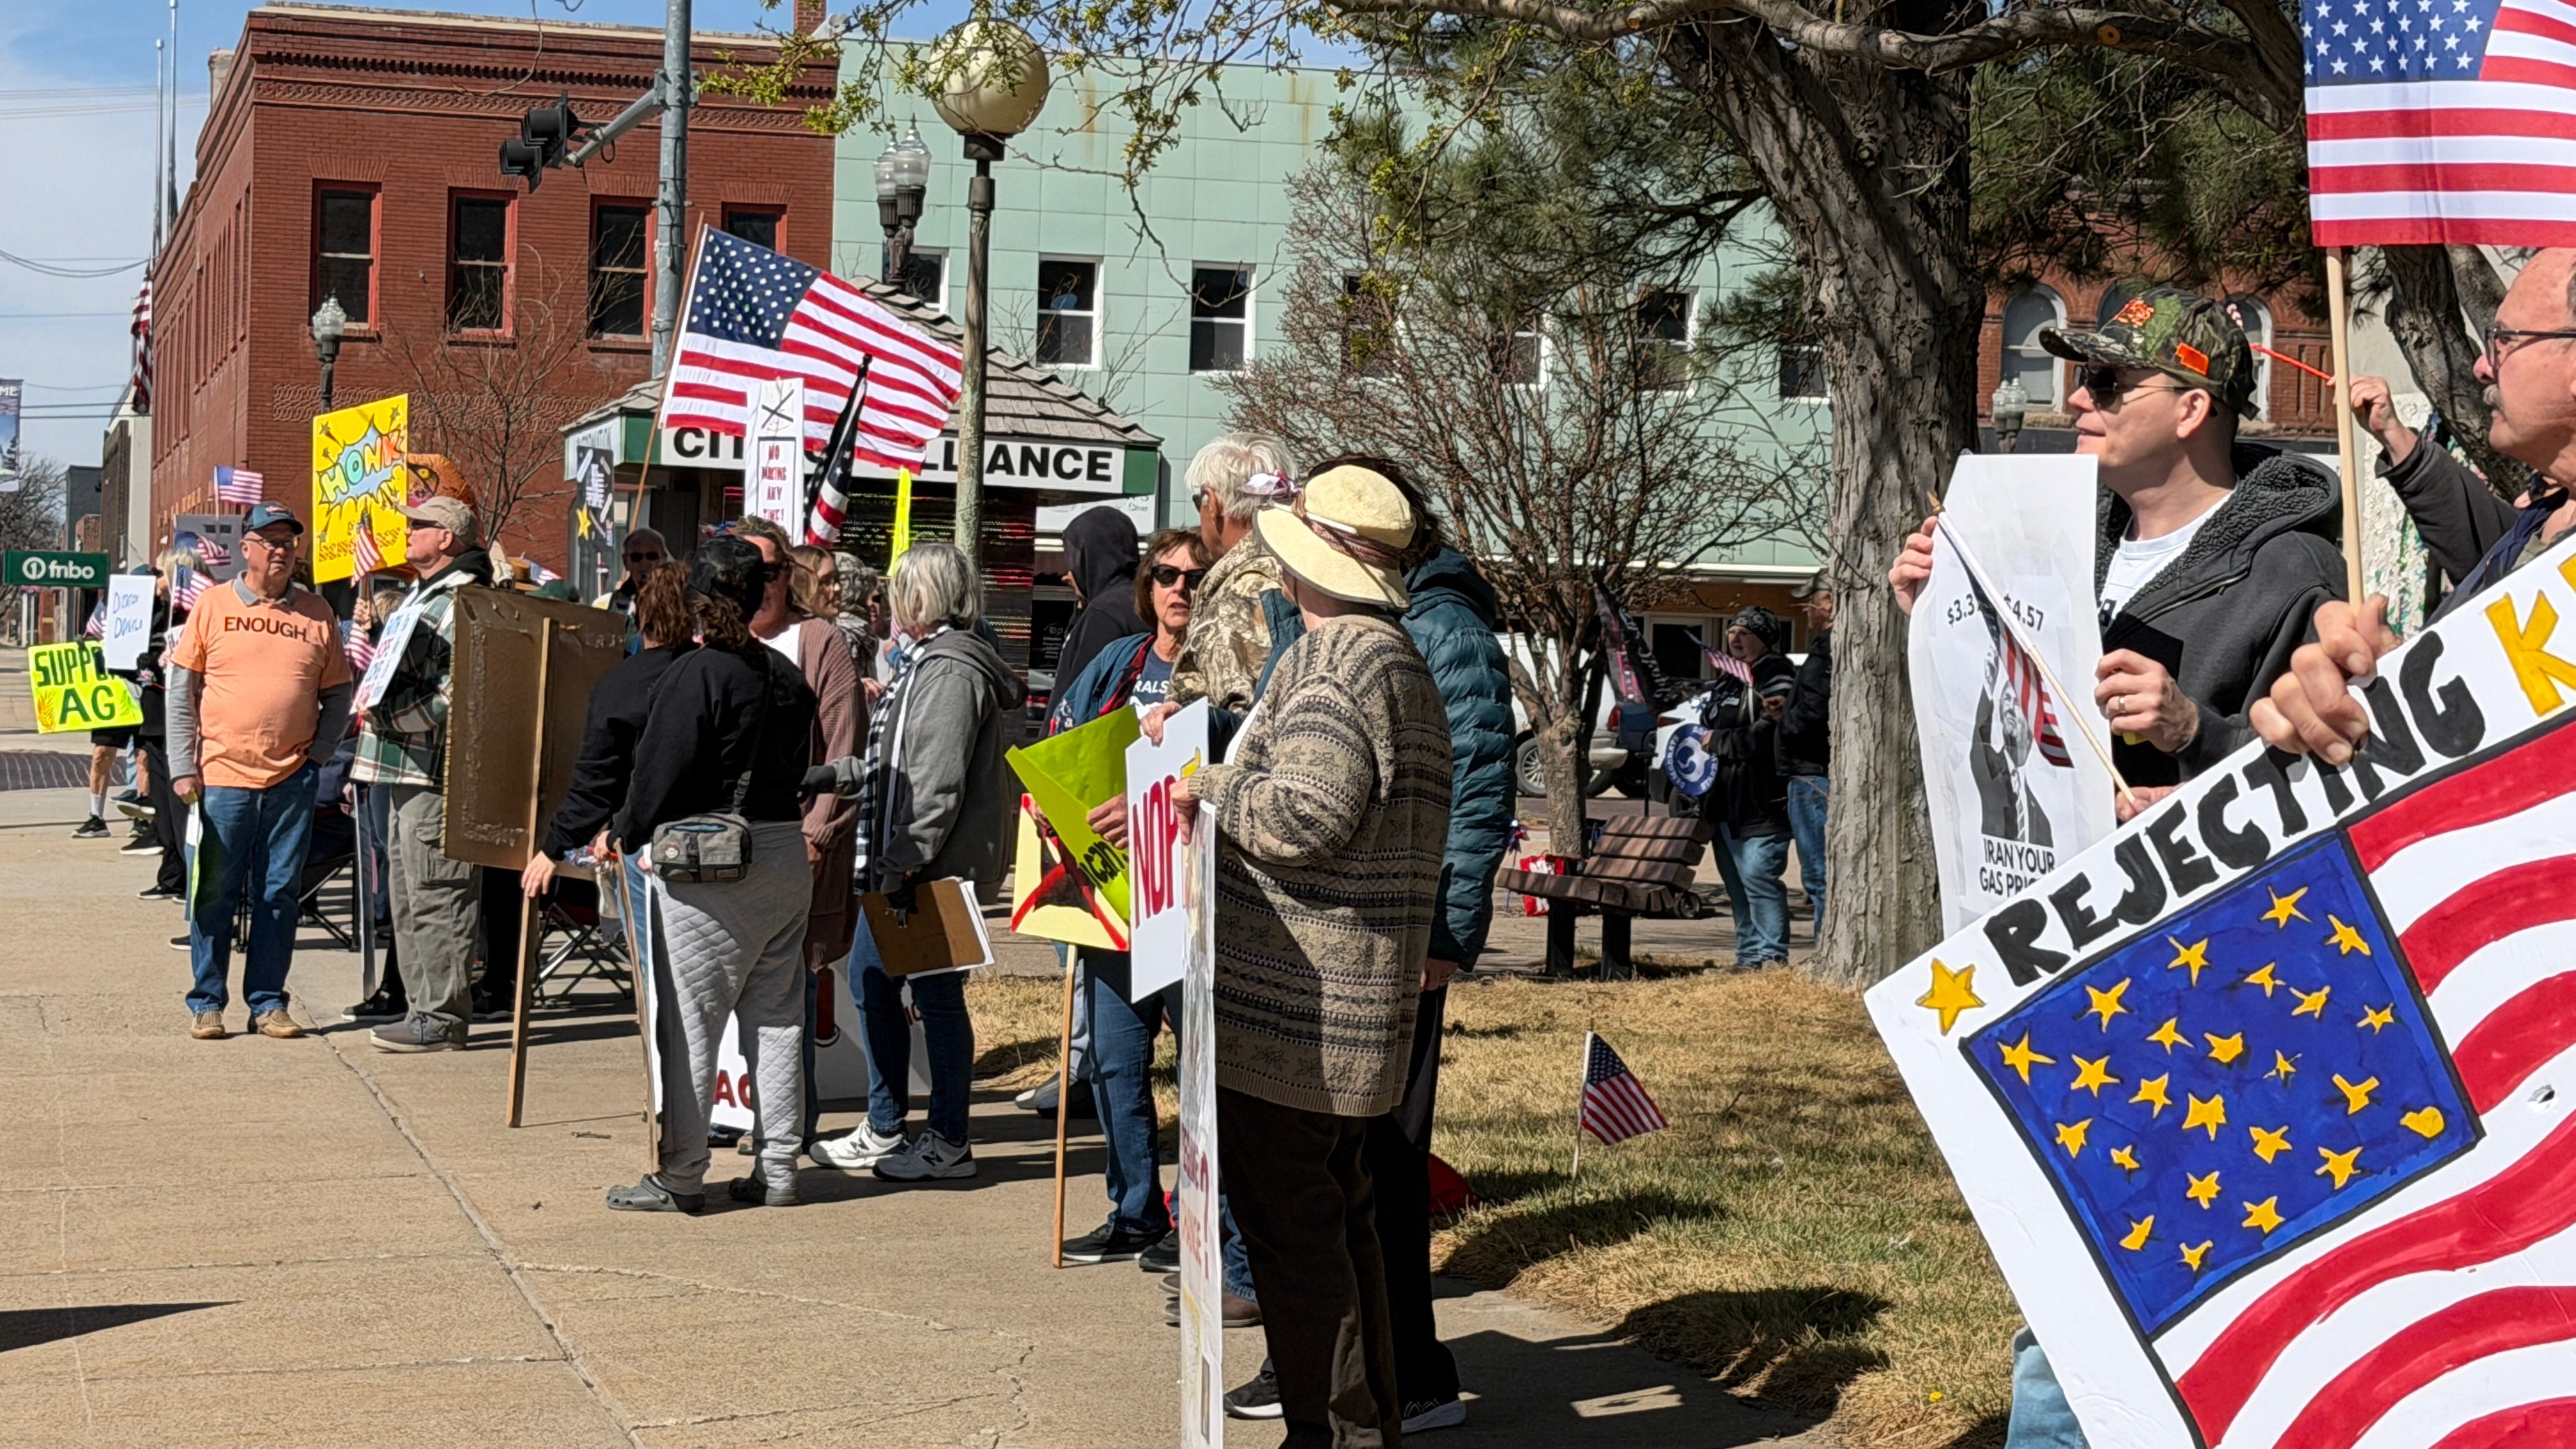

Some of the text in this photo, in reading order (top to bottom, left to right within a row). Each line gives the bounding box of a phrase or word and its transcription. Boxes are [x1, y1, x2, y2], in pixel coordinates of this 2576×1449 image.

[673, 426, 744, 460] CIT
[769, 443, 780, 461] NO
[320, 430, 402, 504] HONK
[767, 486, 783, 501] ANY
[49, 560, 95, 579] fnbo
[1947, 593, 1980, 627] $3.3
[34, 645, 114, 687] SUPPO
[1133, 680, 1170, 694] RALS
[59, 684, 116, 725] AG
[1982, 553, 2576, 987] REJECTING K
[1132, 774, 1178, 930] NOP
[1983, 838, 2055, 875] IRAN YOUR
[1979, 866, 2037, 898] GAS PRI
